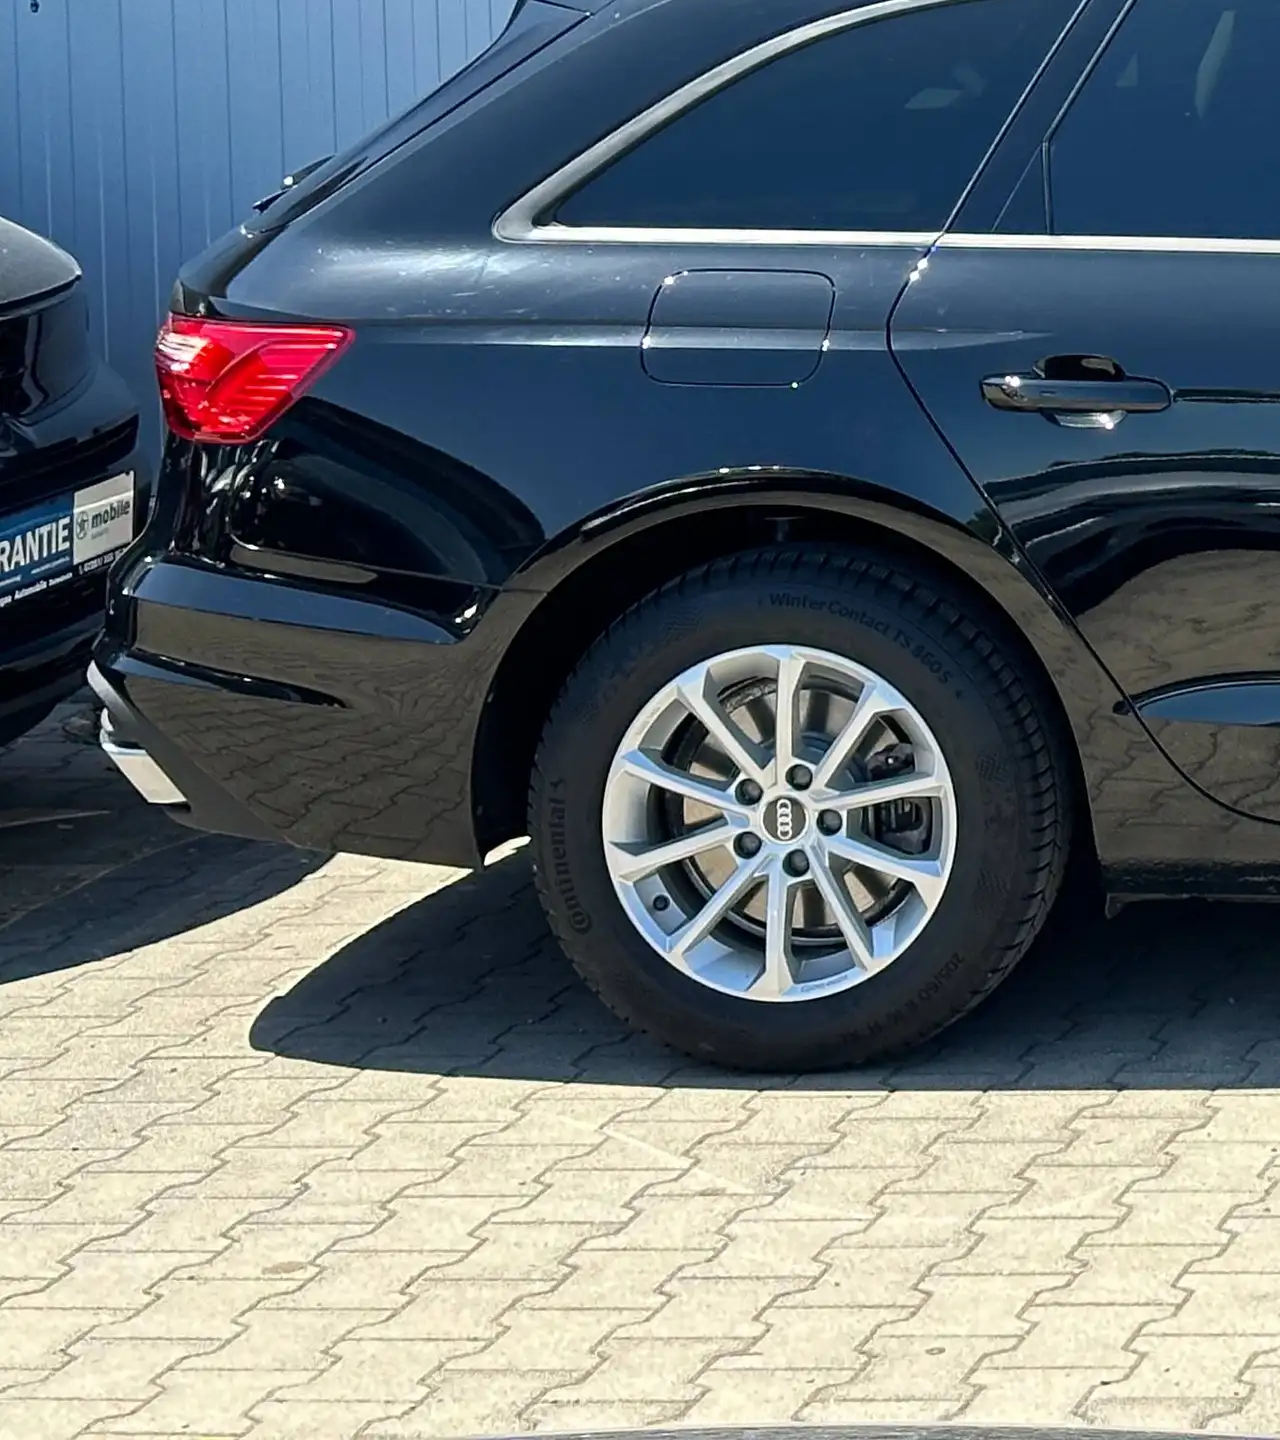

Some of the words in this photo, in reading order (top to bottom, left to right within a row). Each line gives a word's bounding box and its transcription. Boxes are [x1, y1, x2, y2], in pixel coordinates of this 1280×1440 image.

[91, 499, 131, 529] mobile
[767, 592, 891, 637] WinterContact
[548, 796, 593, 935] Continental
